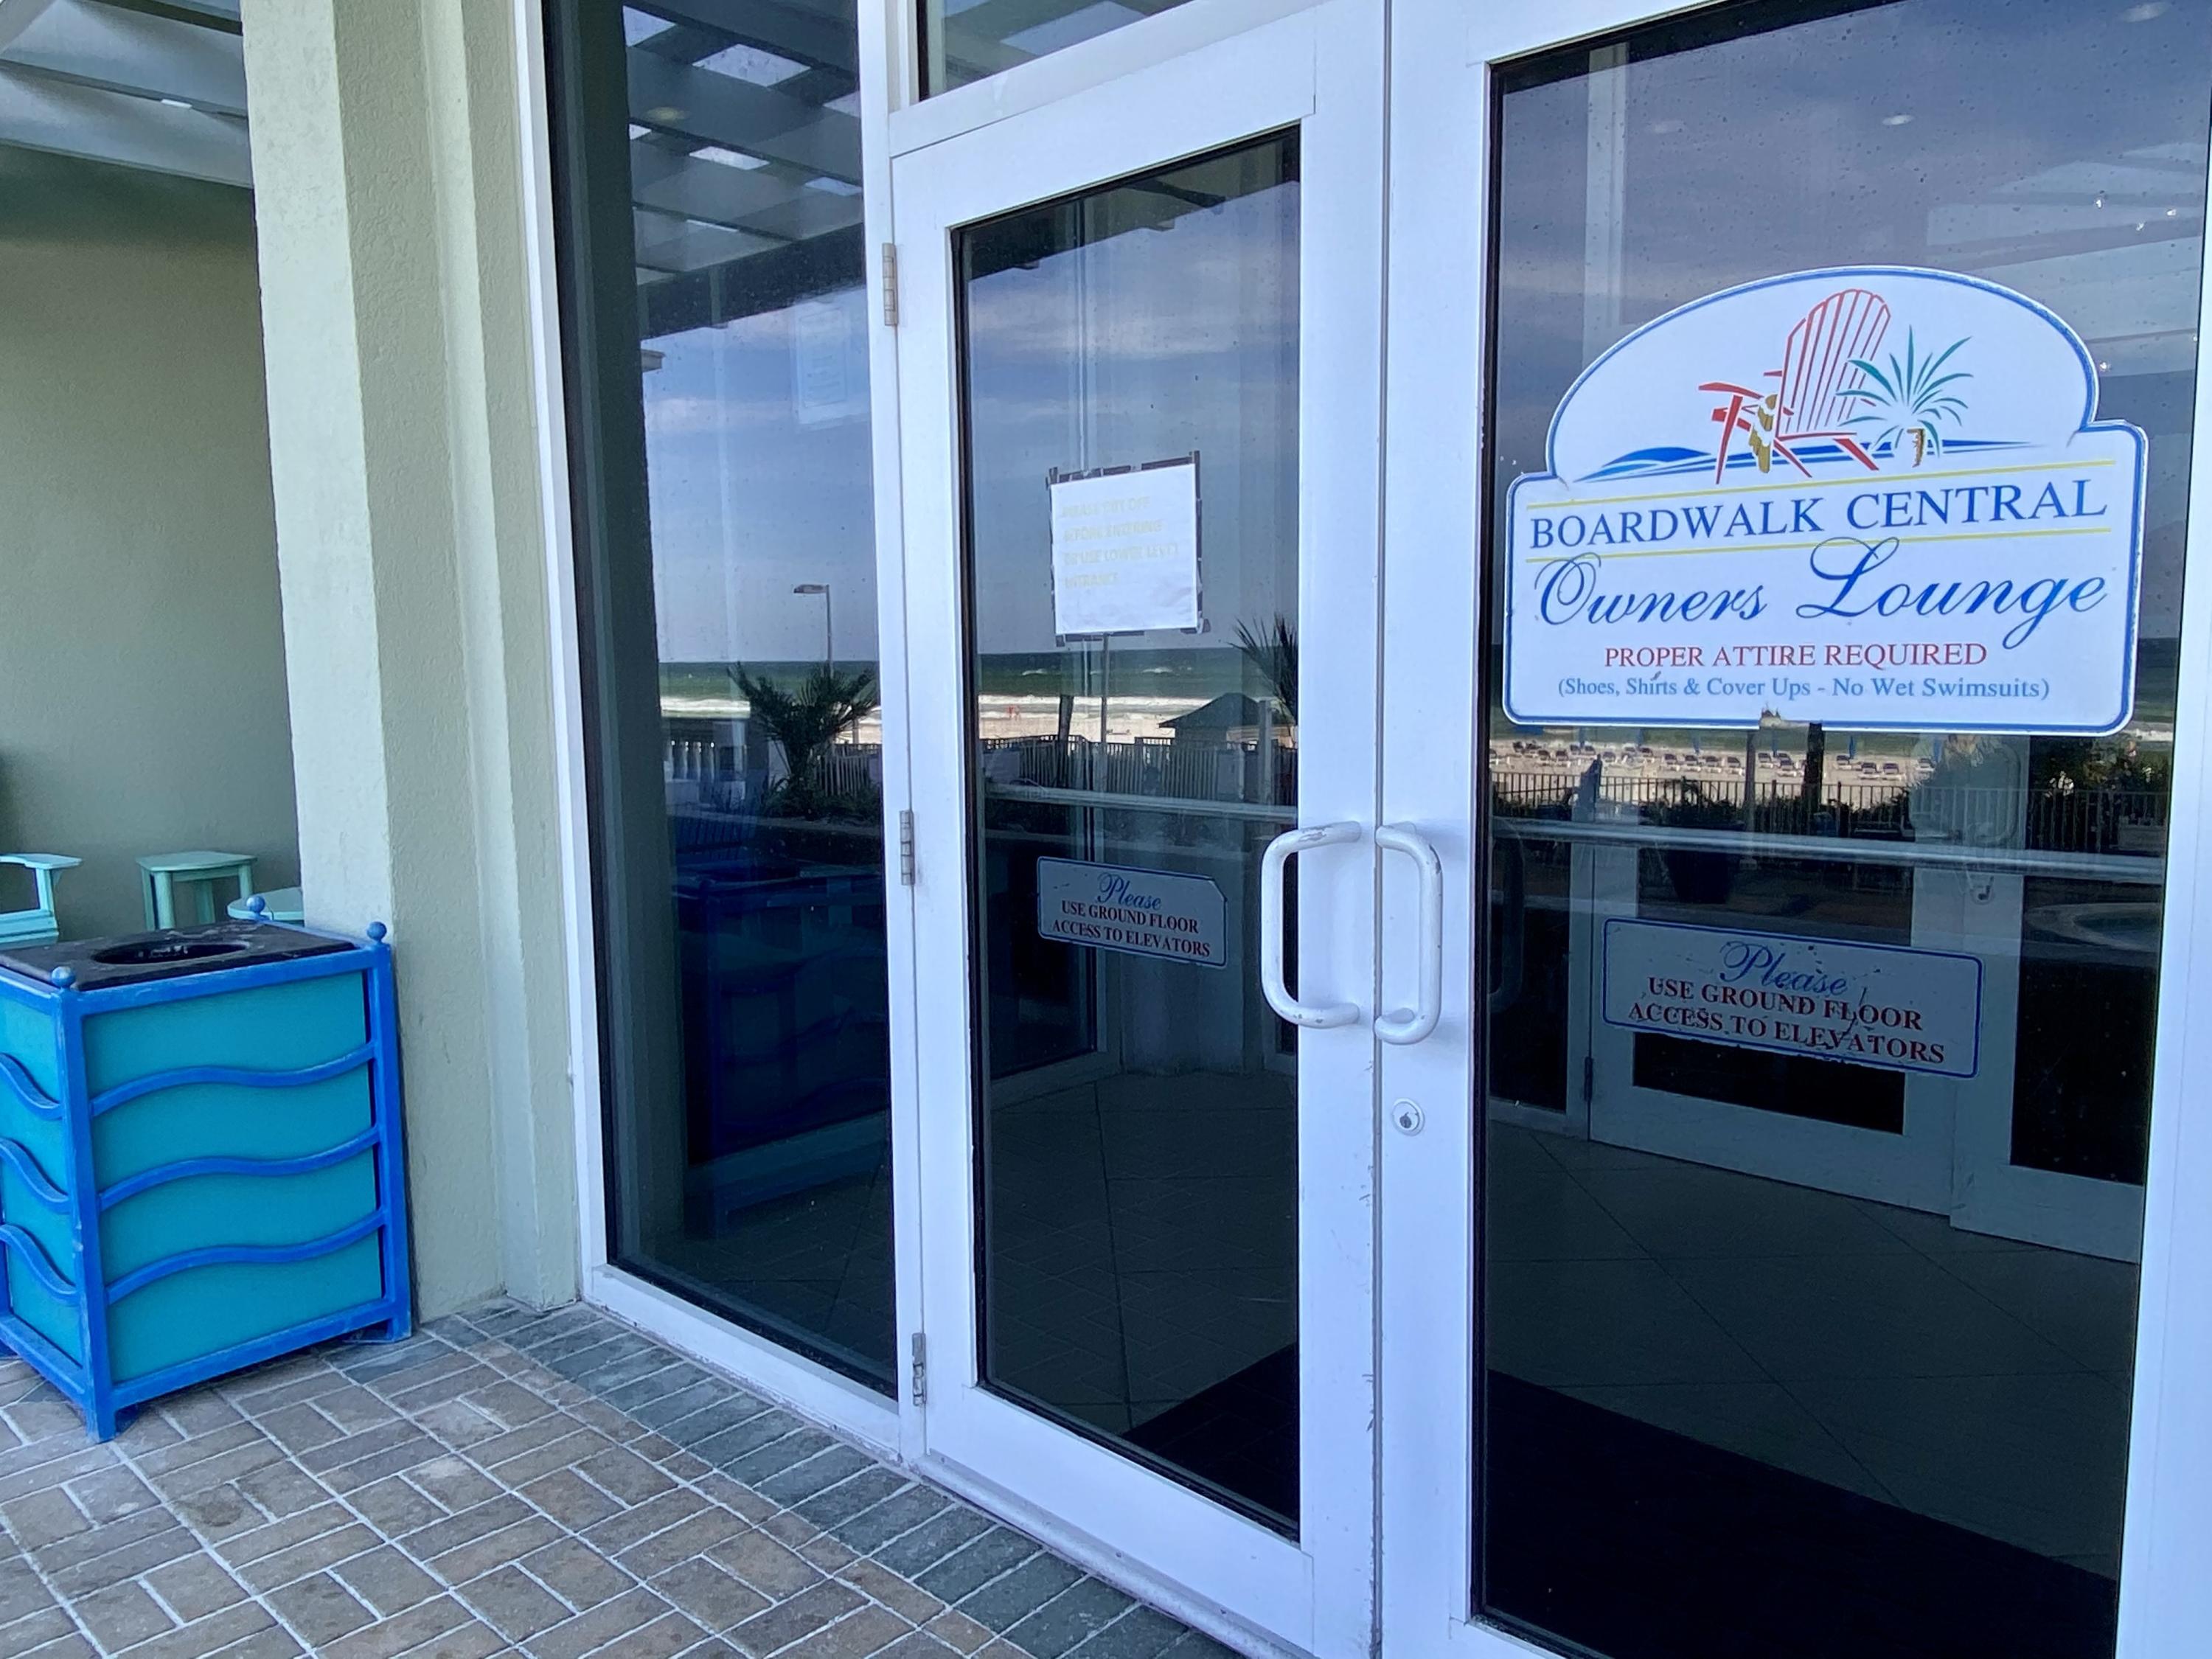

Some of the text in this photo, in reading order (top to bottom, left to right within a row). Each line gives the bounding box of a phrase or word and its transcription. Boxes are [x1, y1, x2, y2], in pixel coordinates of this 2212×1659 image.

[1531, 479, 2108, 550] BOARDWALK CENTRAL
[1534, 536, 2108, 649] Owners Lounge
[1605, 643, 1988, 669] PROPER ATTIRE REQUIRED
[1558, 678, 1621, 698] (Shoes,
[1625, 675, 1678, 696] Shirts
[1683, 678, 1700, 695] &
[1706, 678, 1766, 696] Cover
[1772, 678, 1811, 700] Ups
[1832, 679, 1865, 696] No
[1871, 678, 1916, 698] Wet
[1921, 678, 2050, 700] Swimsuits)
[1097, 872, 1161, 910] Please
[1052, 919, 1210, 957] ACCESS TO ELEVATORS
[1062, 900, 1199, 933] USE GROUND FLOOR
[1719, 941, 1848, 995] Please
[1648, 976, 1922, 1031] USE GROUND FLOOR
[1629, 1002, 1944, 1064] ACCESS TO ELEVATORS
